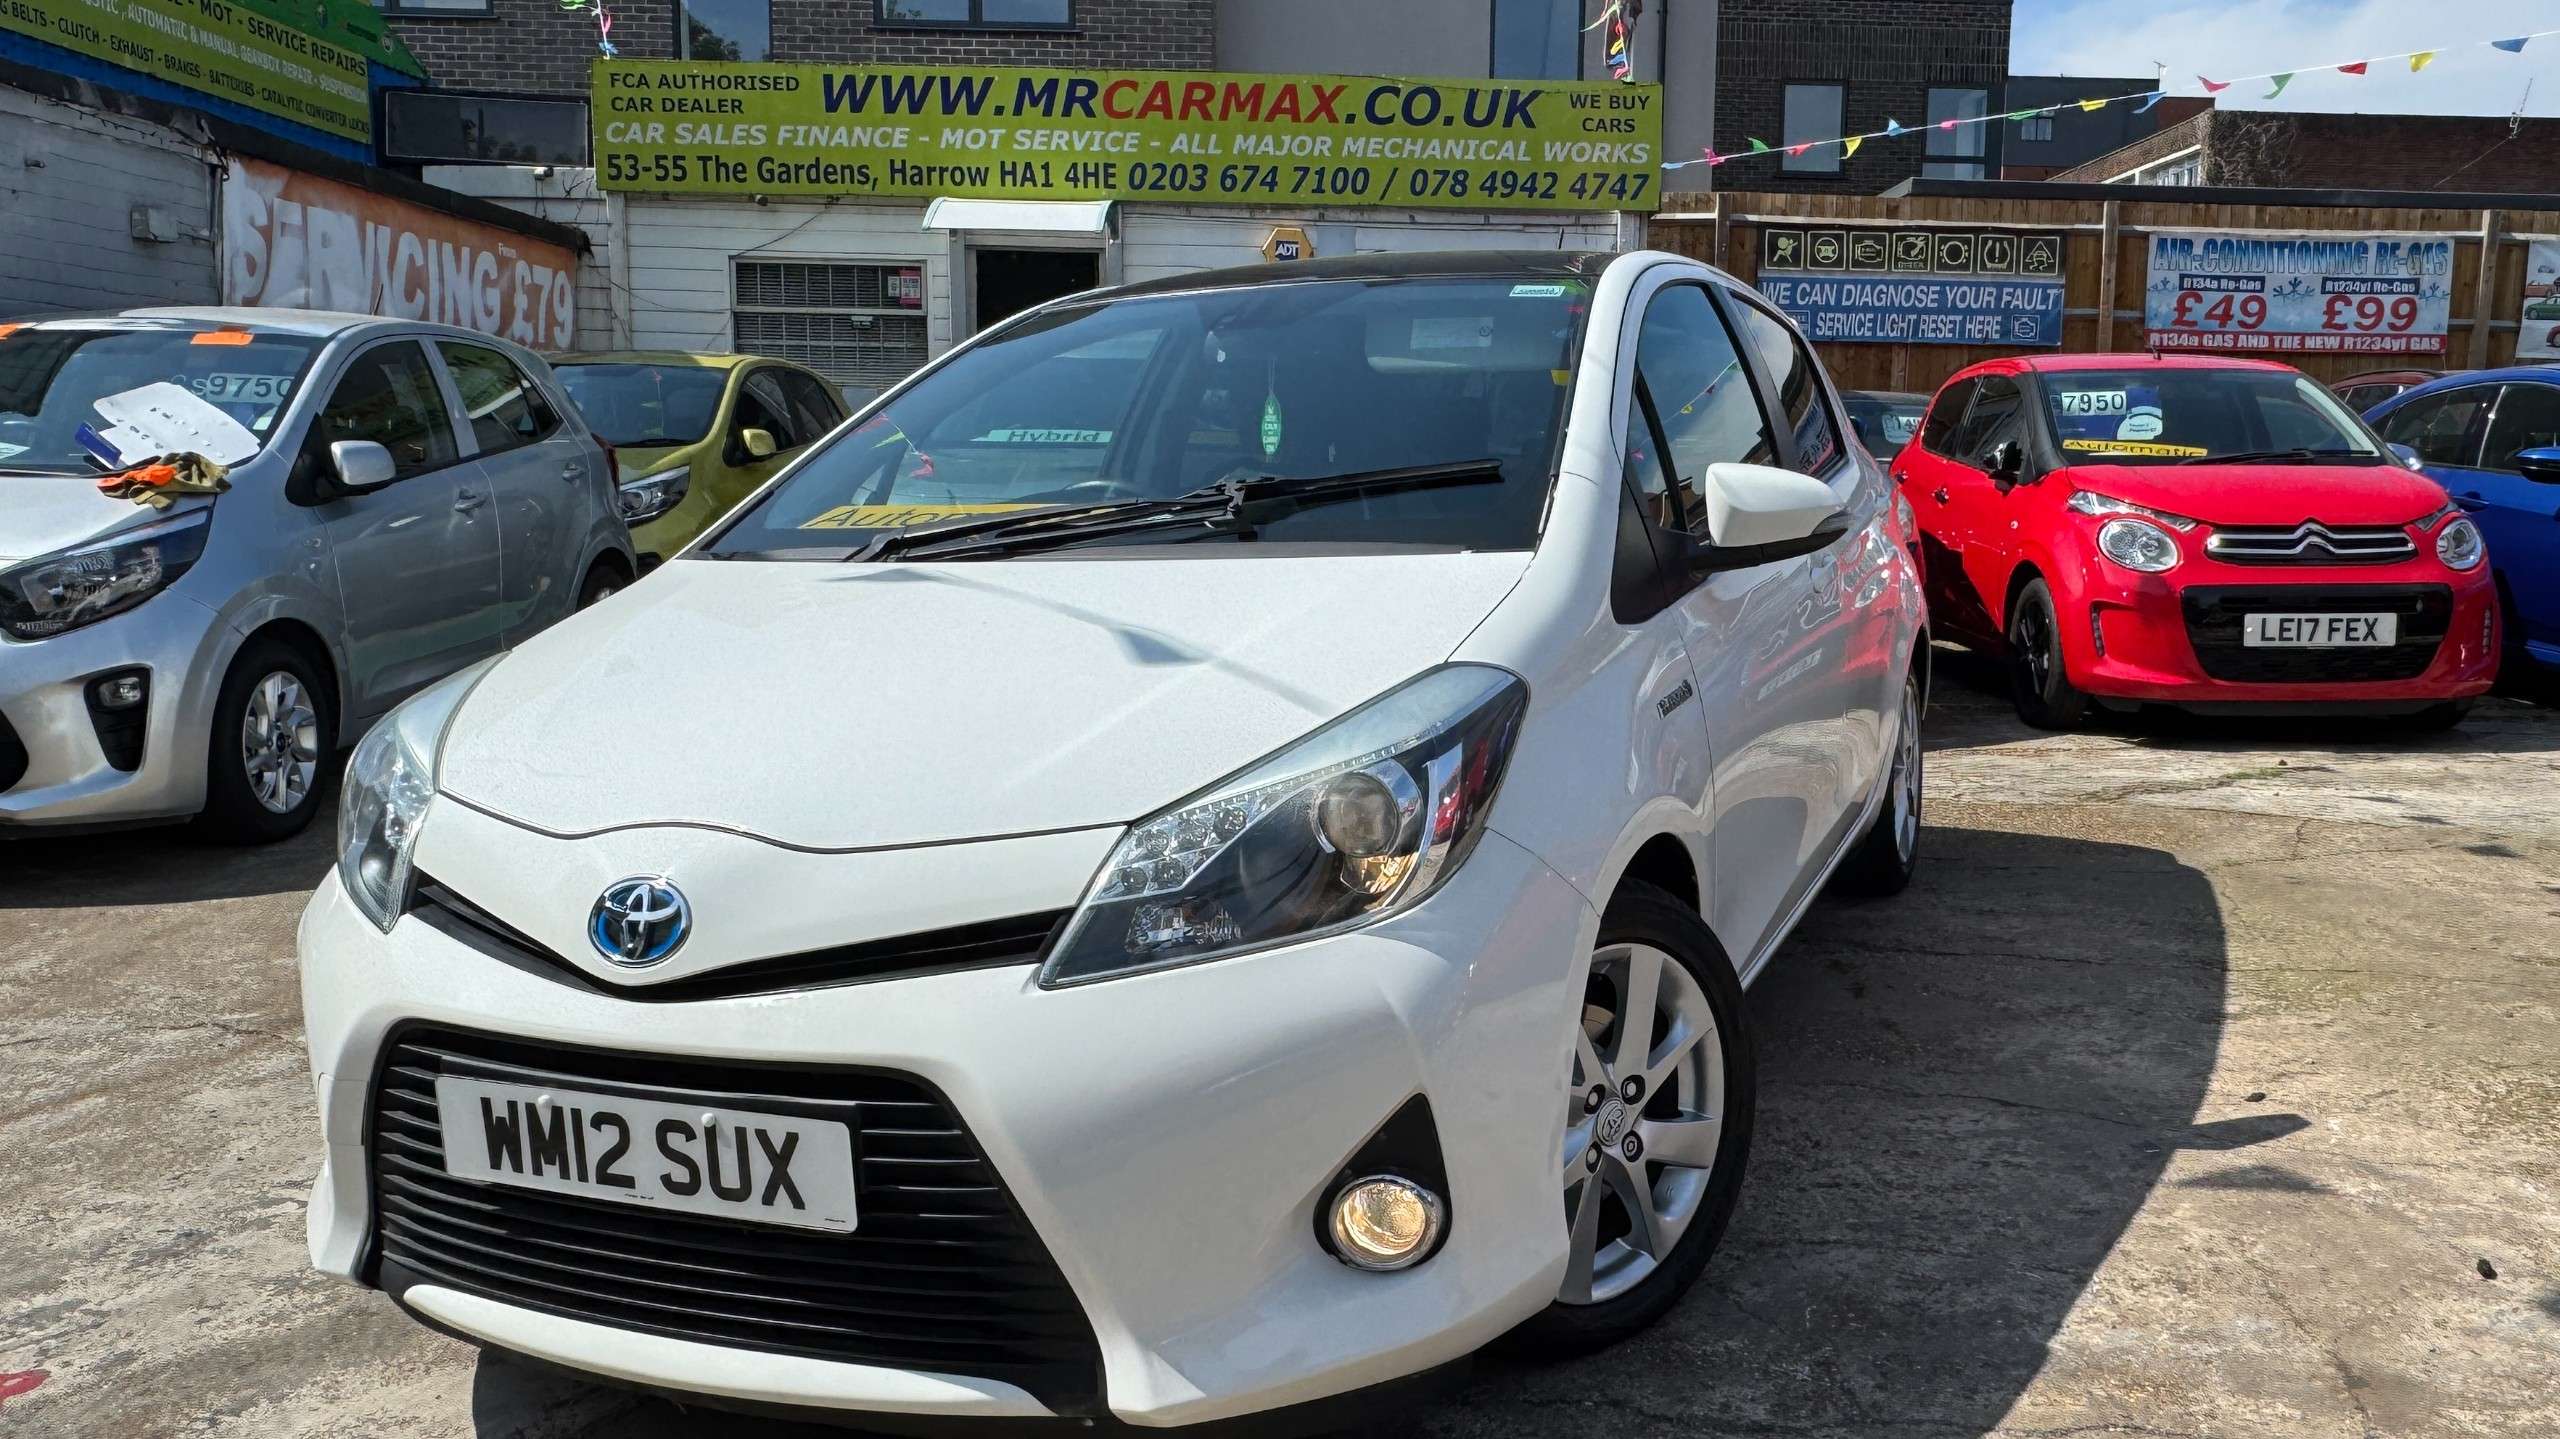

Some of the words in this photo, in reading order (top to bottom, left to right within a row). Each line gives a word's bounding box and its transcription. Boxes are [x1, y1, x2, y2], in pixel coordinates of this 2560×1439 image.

[11, 2, 47, 28] BELTS
[58, 17, 100, 44] CLUTCH
[110, 35, 154, 64] EXHAUST
[164, 54, 201, 78] BRAKES
[201, 1, 232, 25] MOT
[248, 17, 307, 55] SERVICE
[311, 41, 367, 77] REPAIRS
[610, 72, 651, 89] FCA
[658, 74, 800, 92] AUTHORISED
[610, 96, 654, 113] CAR
[662, 97, 745, 115] DEALER
[822, 73, 1544, 129] WWW.MRCARMAX.CO.UK
[1569, 92, 1605, 110] WE
[1609, 94, 1650, 112] BUY
[1582, 115, 1636, 133] CARS
[606, 121, 665, 144] CAR
[673, 123, 767, 146] SALES
[777, 125, 909, 149] FINANCE
[939, 127, 1003, 151] MOT
[1013, 128, 1140, 154] SERVICE
[1169, 133, 1222, 156] ALL
[1232, 135, 1333, 158] MAJOR
[1341, 137, 1531, 162] MECHANICAL
[1543, 141, 1650, 164] WORKS
[606, 153, 687, 182] 53-55
[697, 155, 748, 183] The
[756, 156, 880, 191] Gardens,
[889, 158, 990, 187] Harrow
[1000, 161, 1054, 188] HA1
[1064, 162, 1117, 190] 4HE
[1128, 162, 1208, 193] 0203
[1219, 165, 1279, 193] 674
[1296, 166, 1370, 195] 7100
[1409, 168, 1468, 198] 078
[1480, 171, 1559, 199] 4942
[1569, 172, 1650, 201] 4747
[1275, 243, 1300, 257] ADT
[2375, 240, 2449, 277] RE-GAS
[224, 180, 500, 335] SERVICING
[510, 259, 574, 349] £79
[1762, 282, 1791, 306] WE
[1796, 282, 1836, 306] CAN
[1841, 284, 1940, 309] DIAGNOSE
[1945, 286, 1998, 310] YOUR
[2001, 288, 2061, 311] FAULT
[2170, 291, 2268, 331] £49
[2322, 294, 2419, 332] £99
[1816, 312, 1873, 337] SERVICE
[1876, 313, 1915, 338] LIGHT
[1918, 314, 1963, 339] RESET
[1965, 315, 2002, 340] HERE
[2202, 334, 2235, 347] GAS
[2237, 334, 2270, 348] AND
[2273, 335, 2302, 349] THE
[2304, 335, 2341, 349] NEW
[2410, 337, 2441, 350] GAS
[208, 375, 294, 398] 9750
[2064, 392, 2125, 413] 7950
[1007, 430, 1103, 443] Hybrid
[2065, 440, 2204, 457] Automatic
[2259, 617, 2320, 642] LE17
[2327, 617, 2378, 642] FEX
[480, 1096, 636, 1190] WM12
[655, 1118, 806, 1210] SUX
